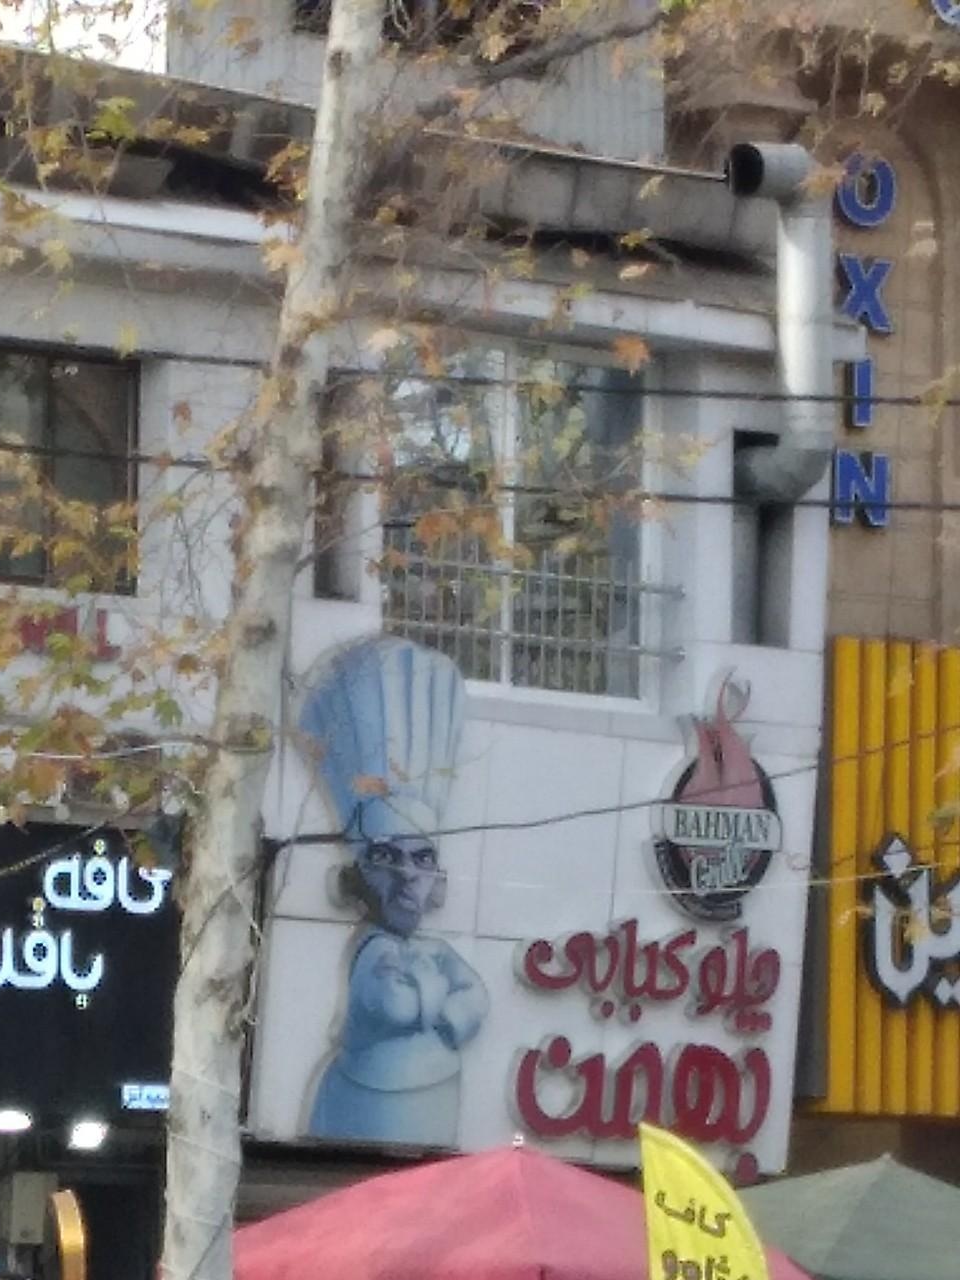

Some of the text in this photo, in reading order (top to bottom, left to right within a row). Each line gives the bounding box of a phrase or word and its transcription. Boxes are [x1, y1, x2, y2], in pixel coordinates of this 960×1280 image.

[836, 150, 897, 527] OXIN
[43, 838, 174, 915] کافه
[517, 1035, 772, 1185] بهمن
